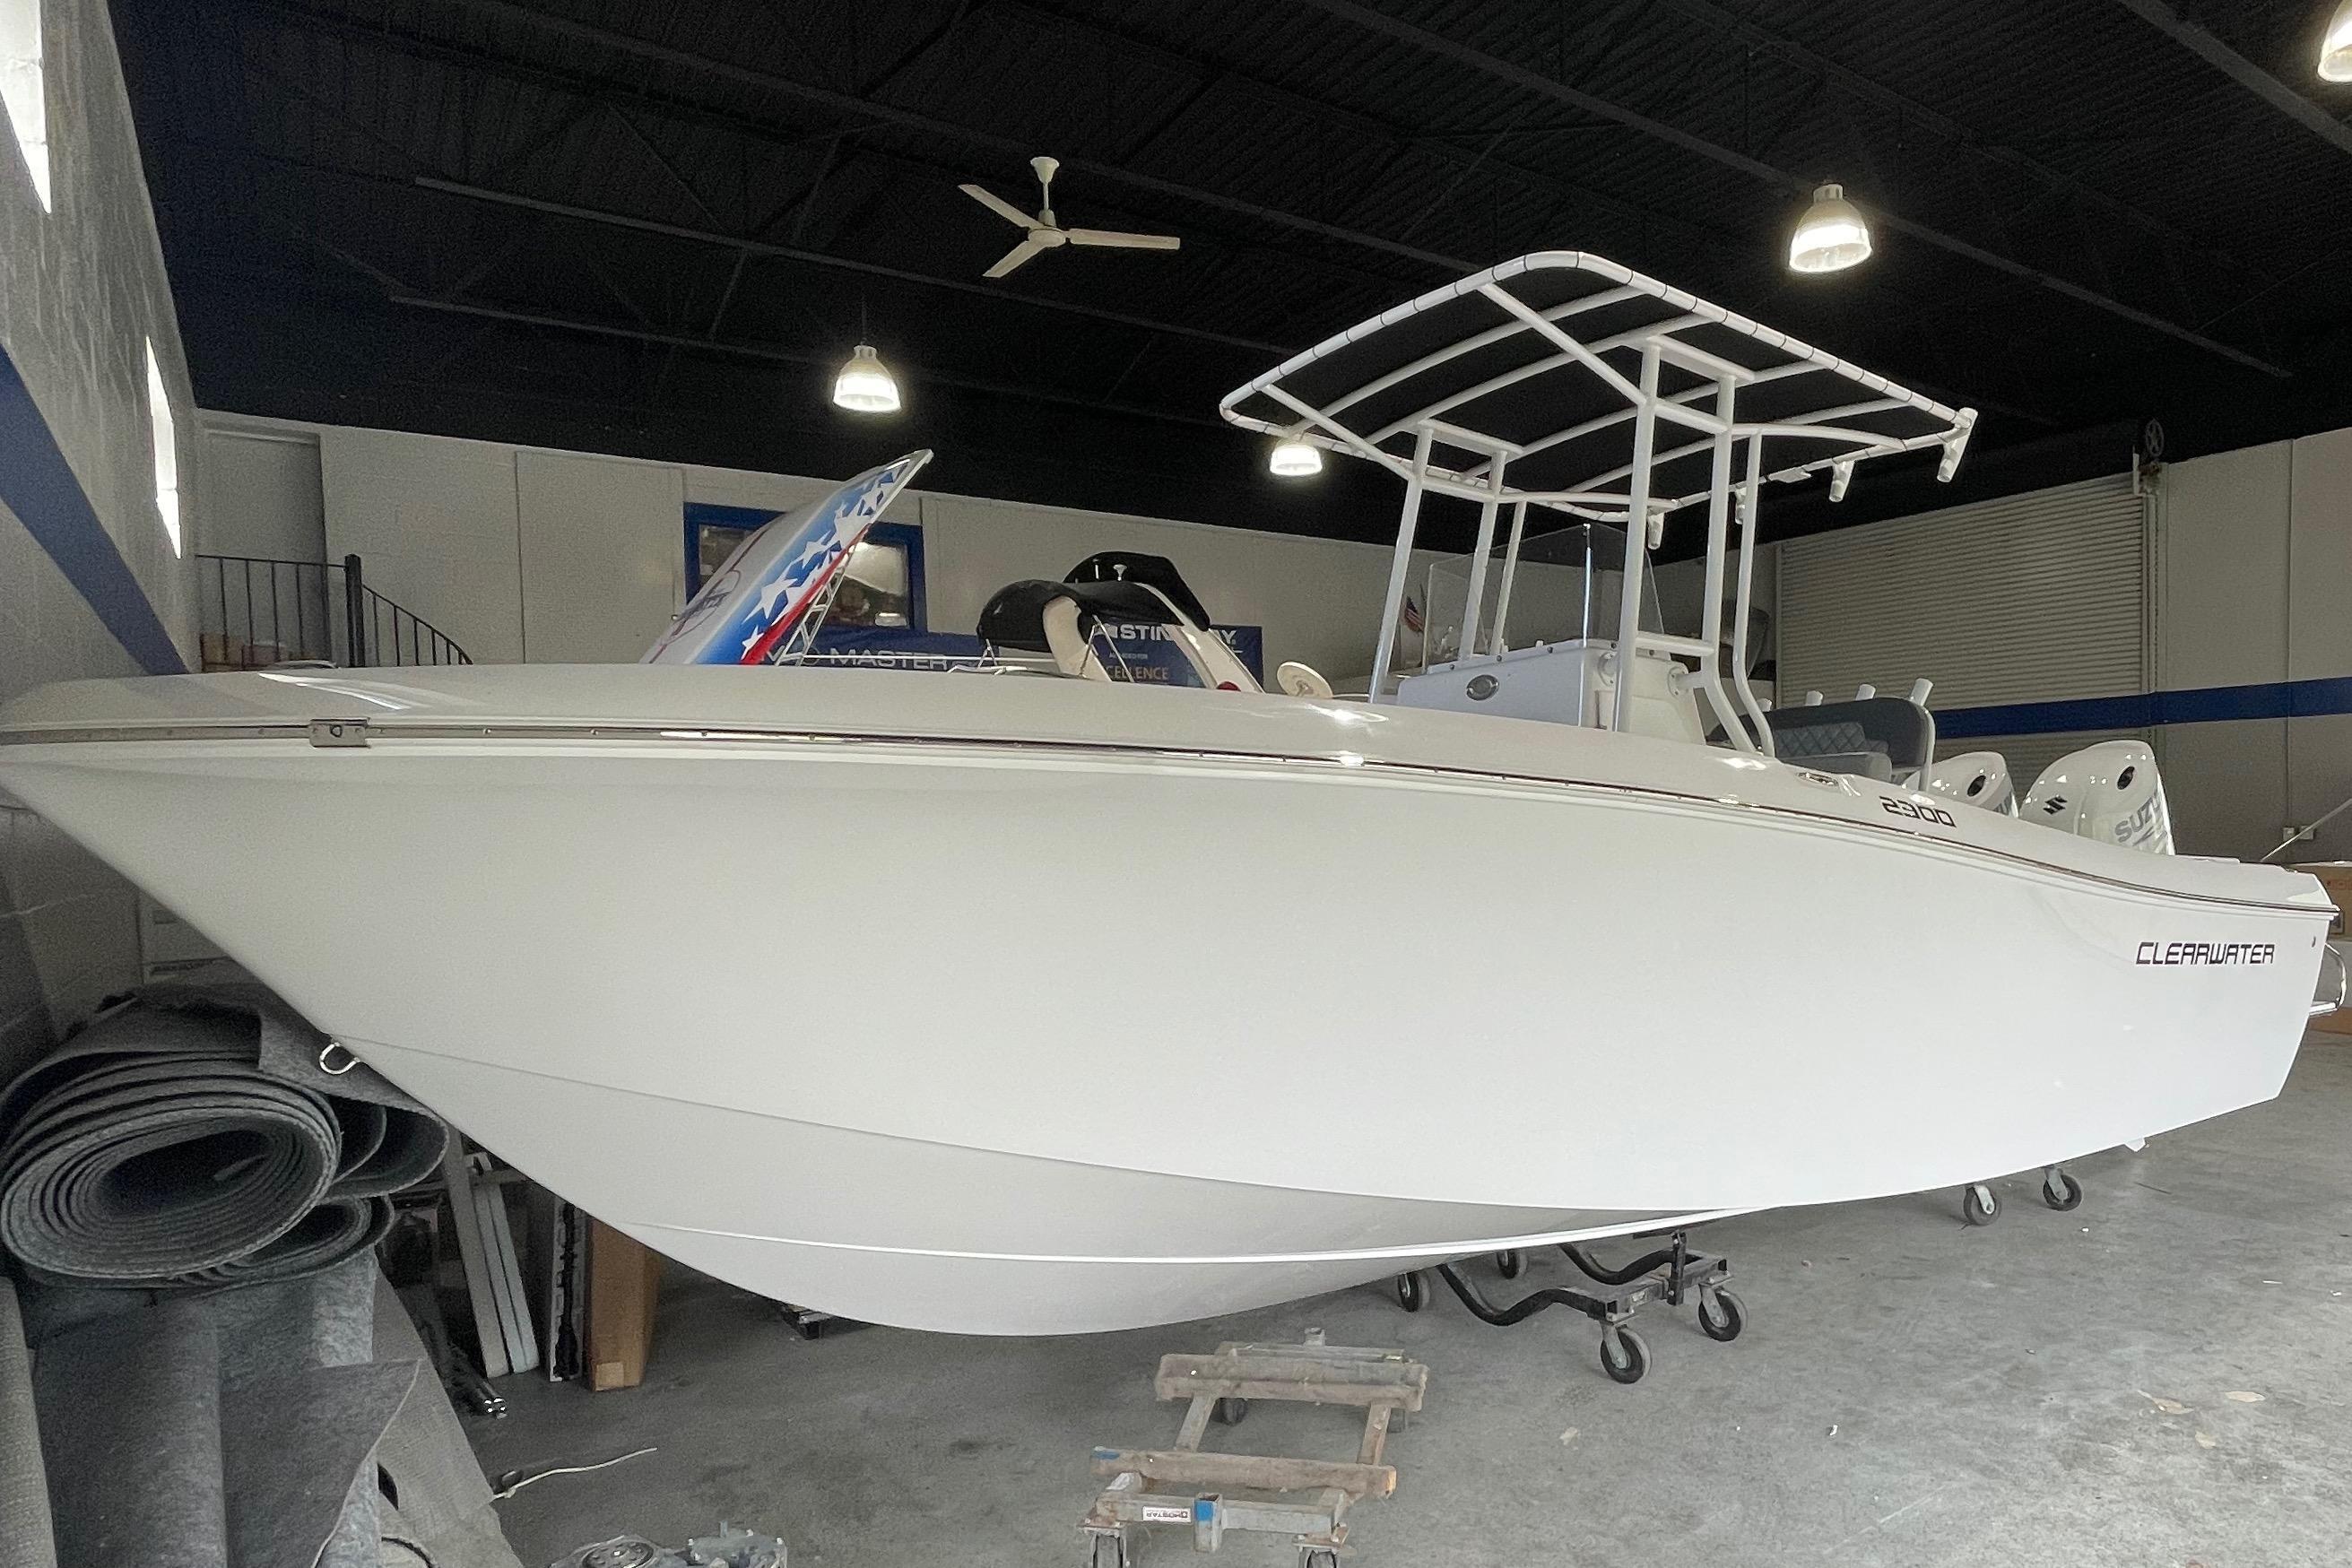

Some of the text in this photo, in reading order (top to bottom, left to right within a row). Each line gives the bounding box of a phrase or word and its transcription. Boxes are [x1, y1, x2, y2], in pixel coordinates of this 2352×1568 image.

[1120, 623, 1237, 644] STINY
[829, 647, 947, 670] MASTER
[1107, 665, 1169, 680] CELLENCE
[1879, 796, 1957, 827] 2300
[2136, 941, 2275, 965] CLEARWATER
